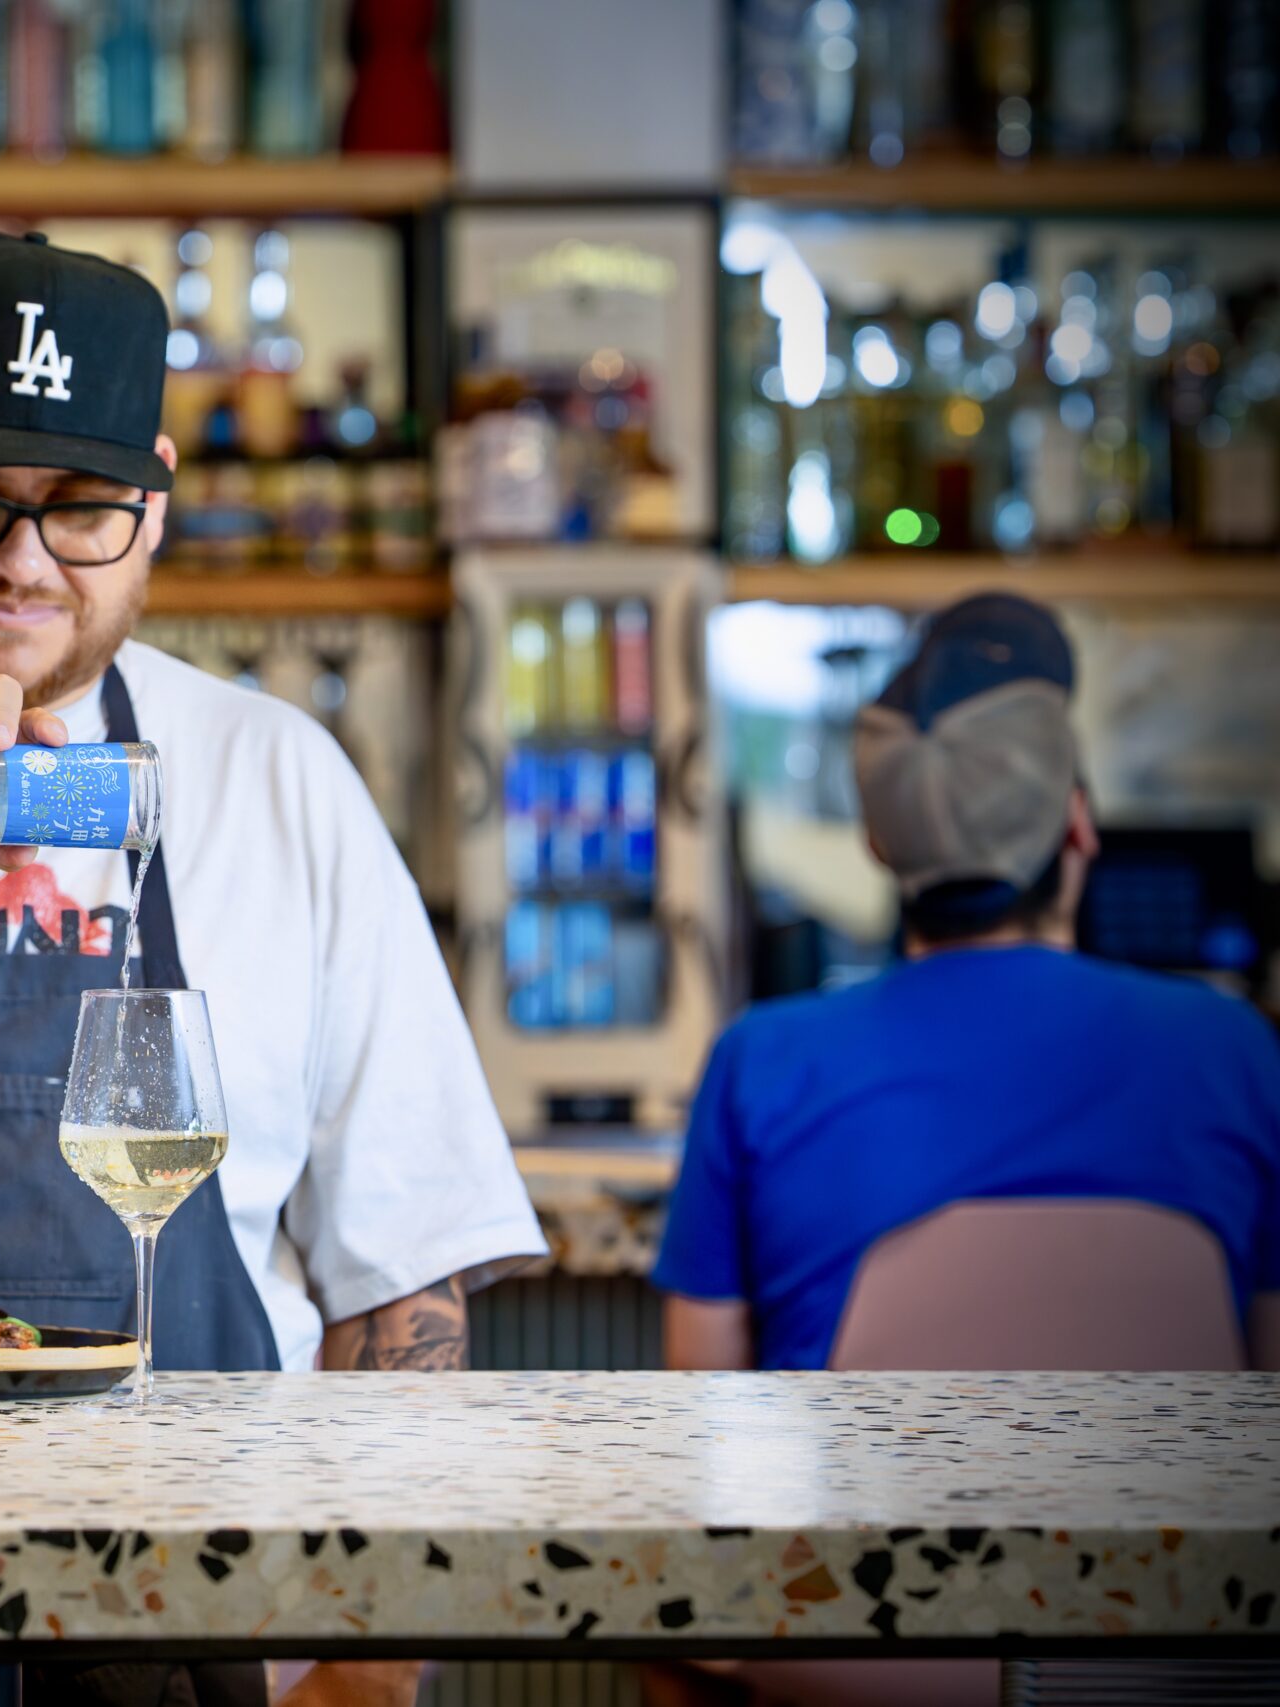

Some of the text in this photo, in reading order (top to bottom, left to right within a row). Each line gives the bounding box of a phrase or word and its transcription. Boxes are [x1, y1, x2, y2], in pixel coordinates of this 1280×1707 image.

[8, 301, 73, 402] LA
[20, 771, 31, 816] 大曲の花火
[53, 807, 106, 832] カップ
[70, 825, 110, 841] 秋田
